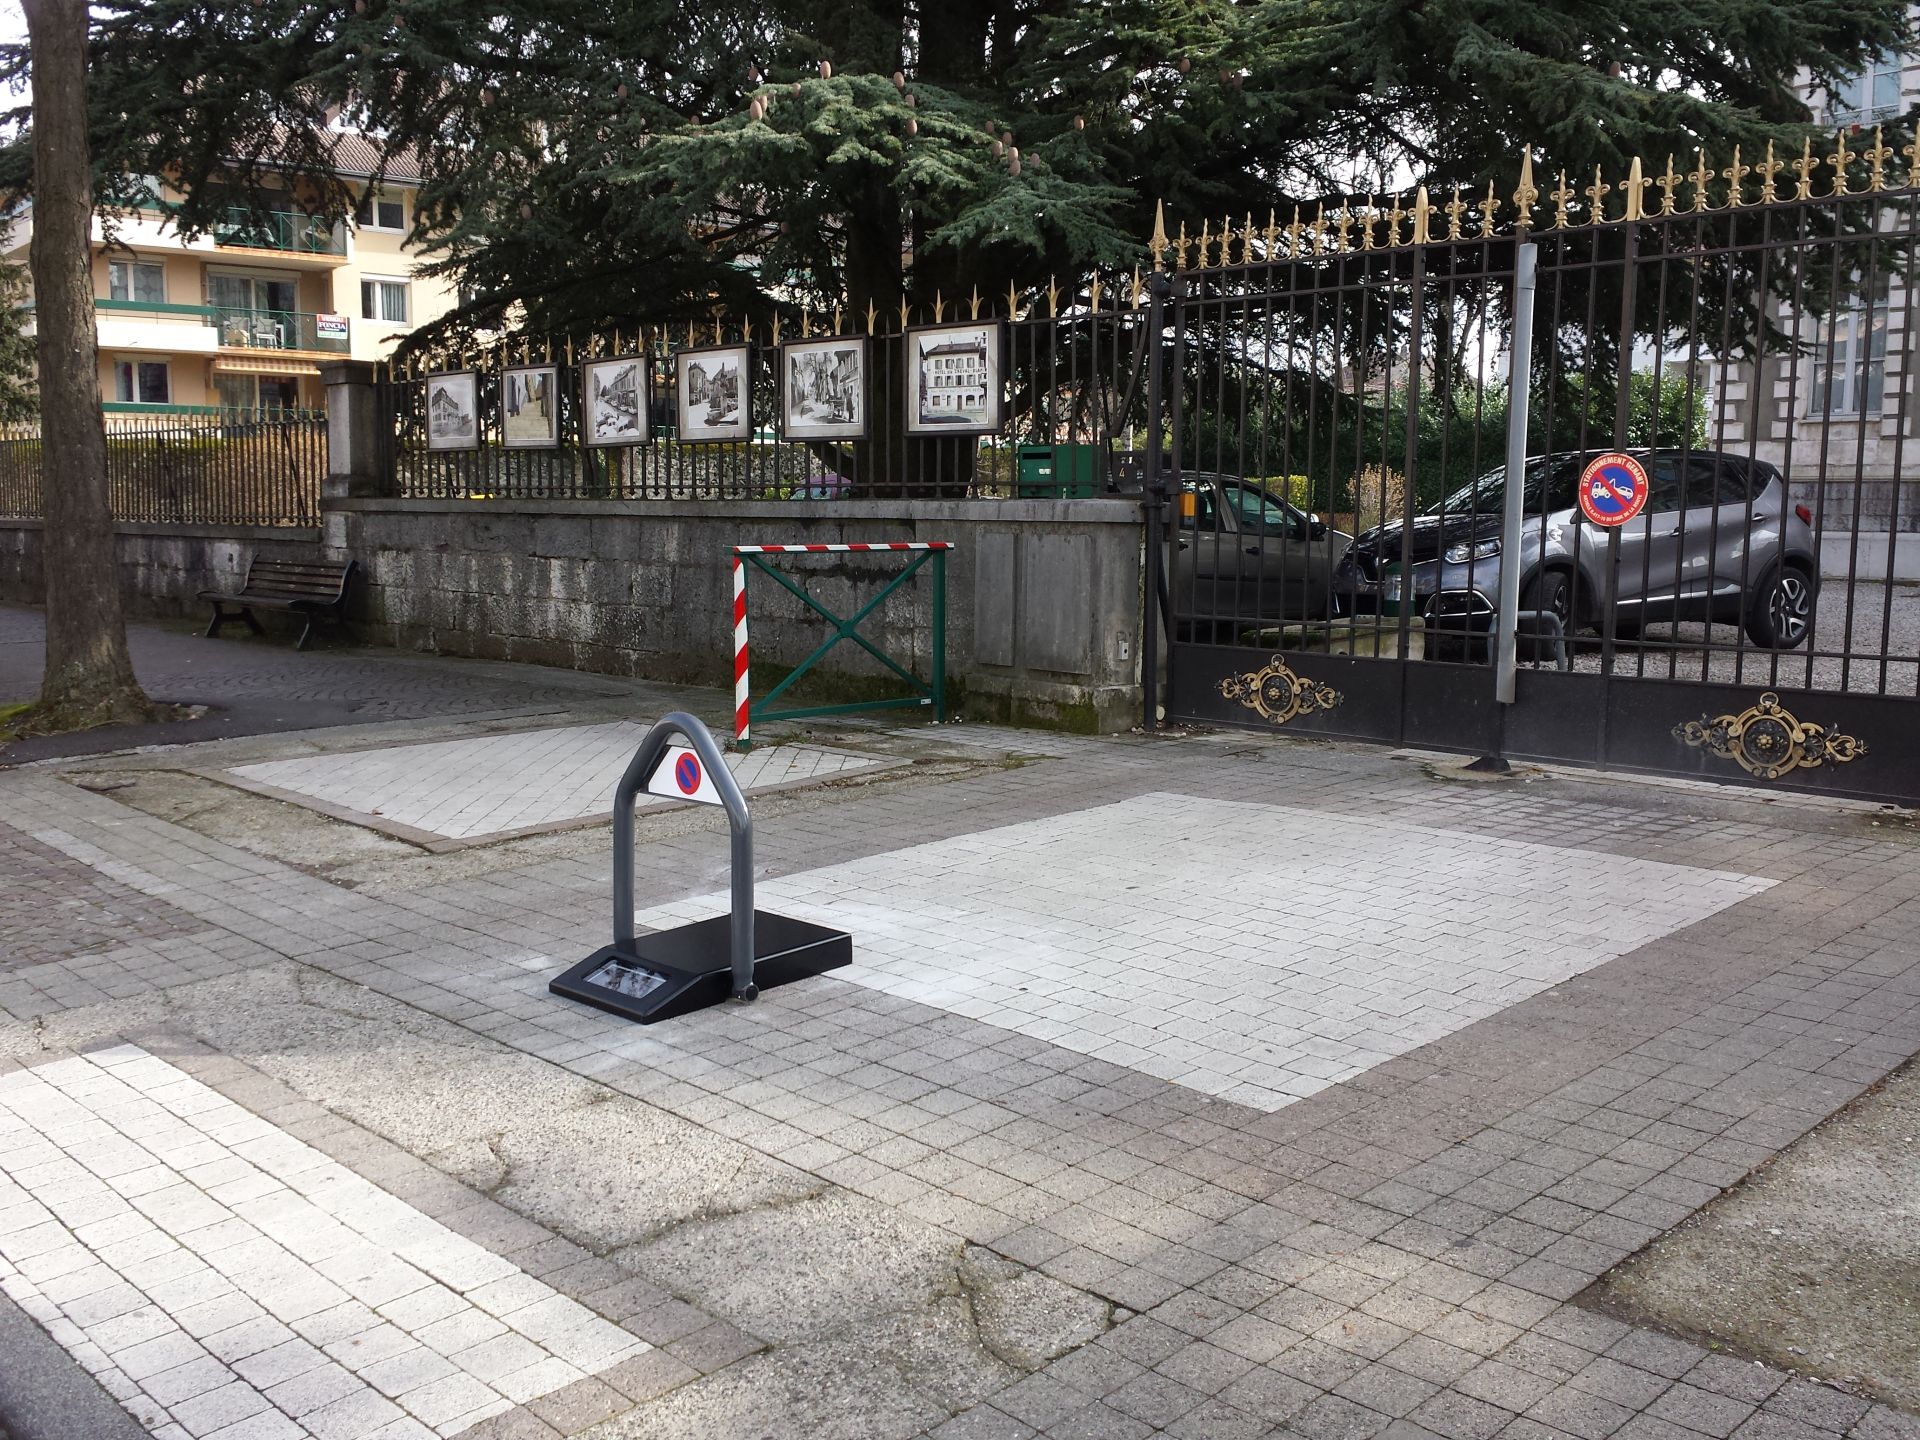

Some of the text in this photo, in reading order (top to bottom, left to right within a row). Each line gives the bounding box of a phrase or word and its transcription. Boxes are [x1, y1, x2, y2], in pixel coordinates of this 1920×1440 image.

[319, 322, 346, 330] FONCIA
[1119, 467, 1125, 478] 4
[1583, 456, 1627, 487] STATIONNEMENT
